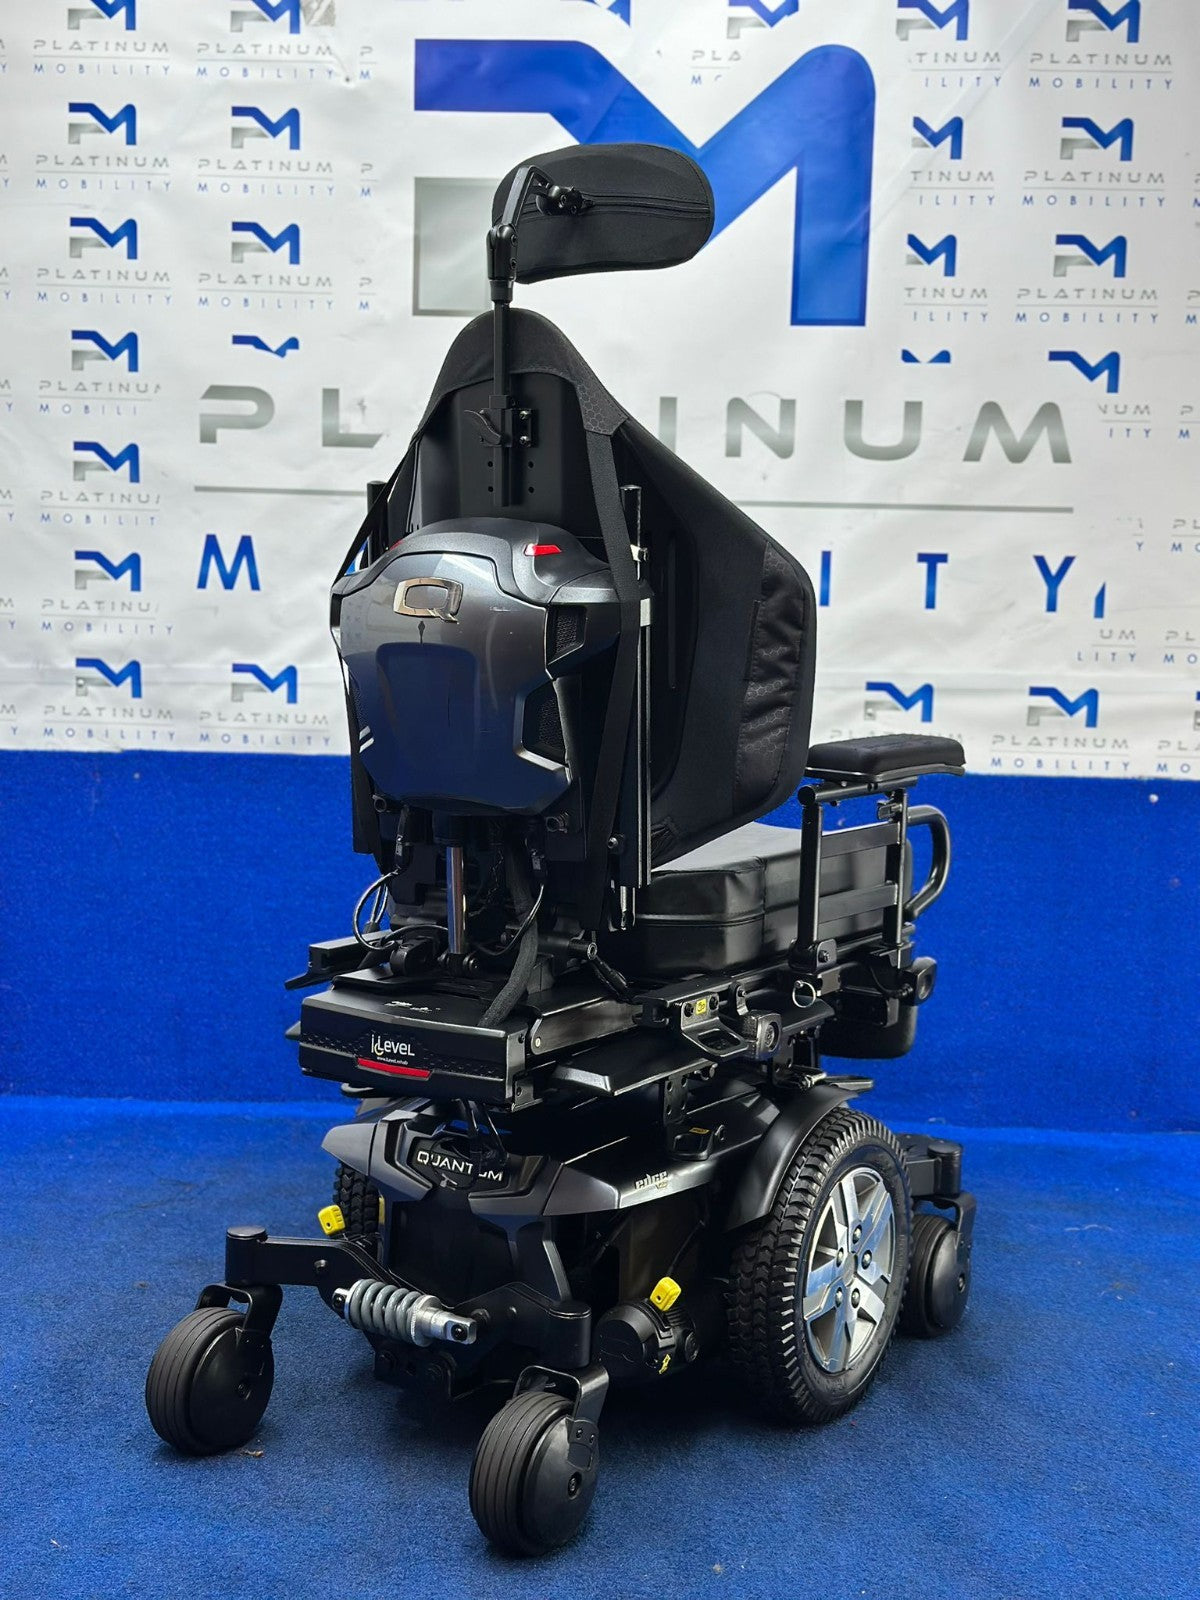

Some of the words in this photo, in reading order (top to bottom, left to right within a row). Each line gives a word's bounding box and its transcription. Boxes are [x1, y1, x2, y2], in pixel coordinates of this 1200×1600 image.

[34, 40, 169, 52] PLATINUM
[197, 43, 332, 55] PLATINUM
[916, 52, 1001, 63] TINUM
[1030, 53, 1172, 65] PLATINUM
[34, 63, 170, 74] MOBILITY
[197, 67, 336, 78] MOBILITY
[923, 77, 1002, 88] ILITY
[1029, 77, 1172, 90] MOBILITY
[36, 155, 168, 167] PLATINUM
[199, 159, 332, 172] PLATINUM
[911, 171, 993, 181] TINUM
[1025, 171, 1164, 183] PLATINUM
[36, 178, 170, 190] MOBILITY
[198, 183, 334, 195] MOBILITY
[920, 195, 994, 205] ILITY
[1023, 195, 1165, 207] MOBILITY
[37, 268, 169, 281] PLATINUM
[199, 273, 331, 286] PLATINUM
[37, 291, 170, 303] MOBILITY
[905, 288, 987, 298] TINUM
[1017, 288, 1157, 300] PLATINUM
[199, 297, 335, 309] MOBILITY
[914, 312, 988, 322] ILITY
[1016, 312, 1158, 323] MOBILITY
[39, 404, 136, 415] MOBILI
[198, 384, 1072, 465] PLINUM
[41, 491, 160, 504] PLATINU
[40, 513, 154, 525] MOBILIT
[197, 534, 1076, 613] MITY
[42, 600, 159, 612] PLATINU
[41, 620, 172, 634] MOBILITY
[44, 706, 173, 719] PLATINUM
[199, 711, 330, 725] PLATINUM
[43, 728, 175, 741] MOBILITY
[199, 733, 332, 746] MOBILITY
[992, 735, 1128, 748] PLATINUM
[990, 758, 1131, 771] MOBILITY
